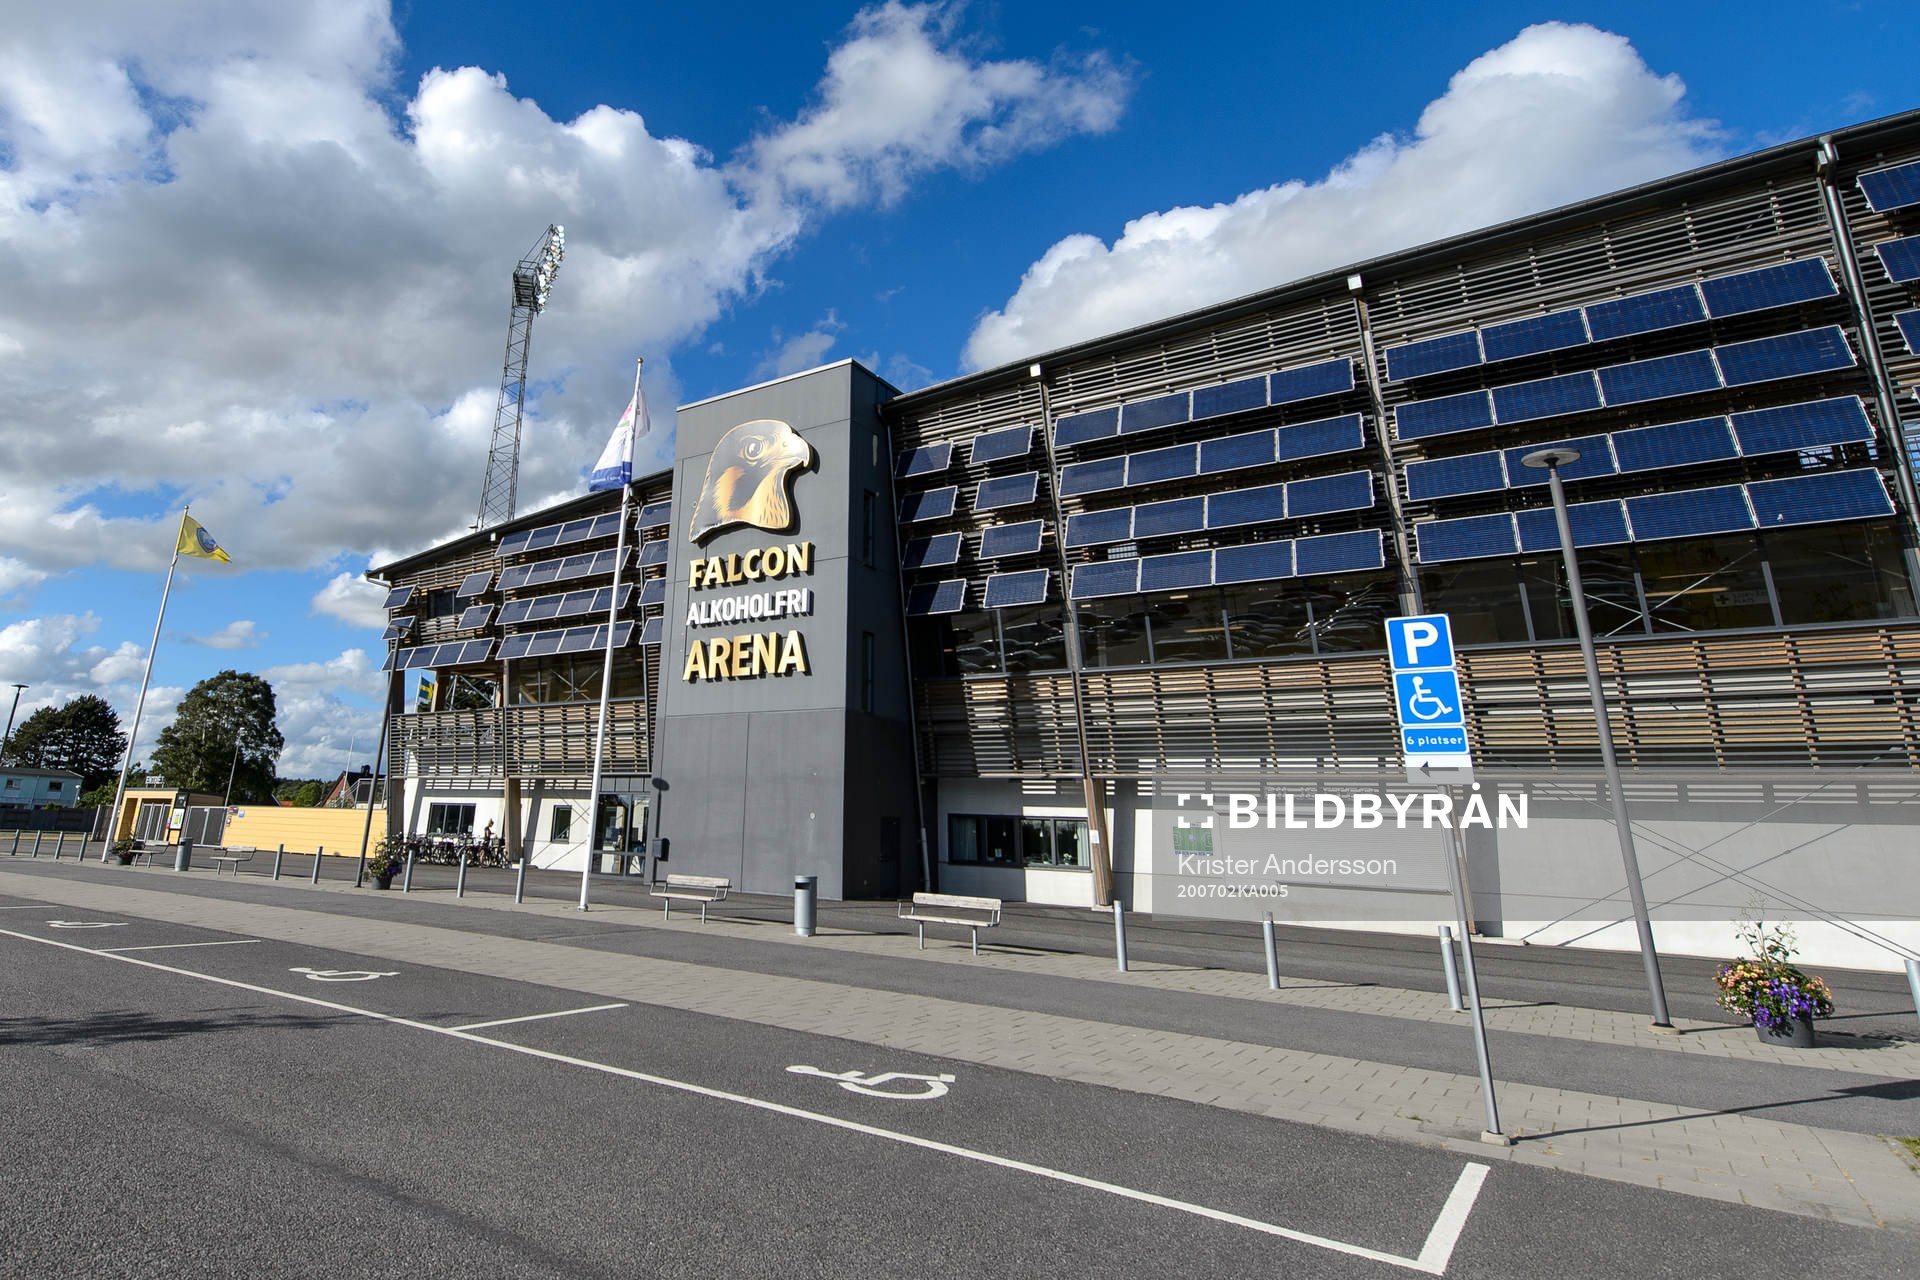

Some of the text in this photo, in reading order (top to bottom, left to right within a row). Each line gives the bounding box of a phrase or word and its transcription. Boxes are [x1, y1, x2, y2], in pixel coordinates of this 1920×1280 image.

[688, 541, 811, 588] FALCON
[686, 588, 809, 626] ALKOHOLFRI
[682, 629, 806, 681] ARENA
[1402, 621, 1439, 665] P
[1407, 735, 1463, 747] 6 platser
